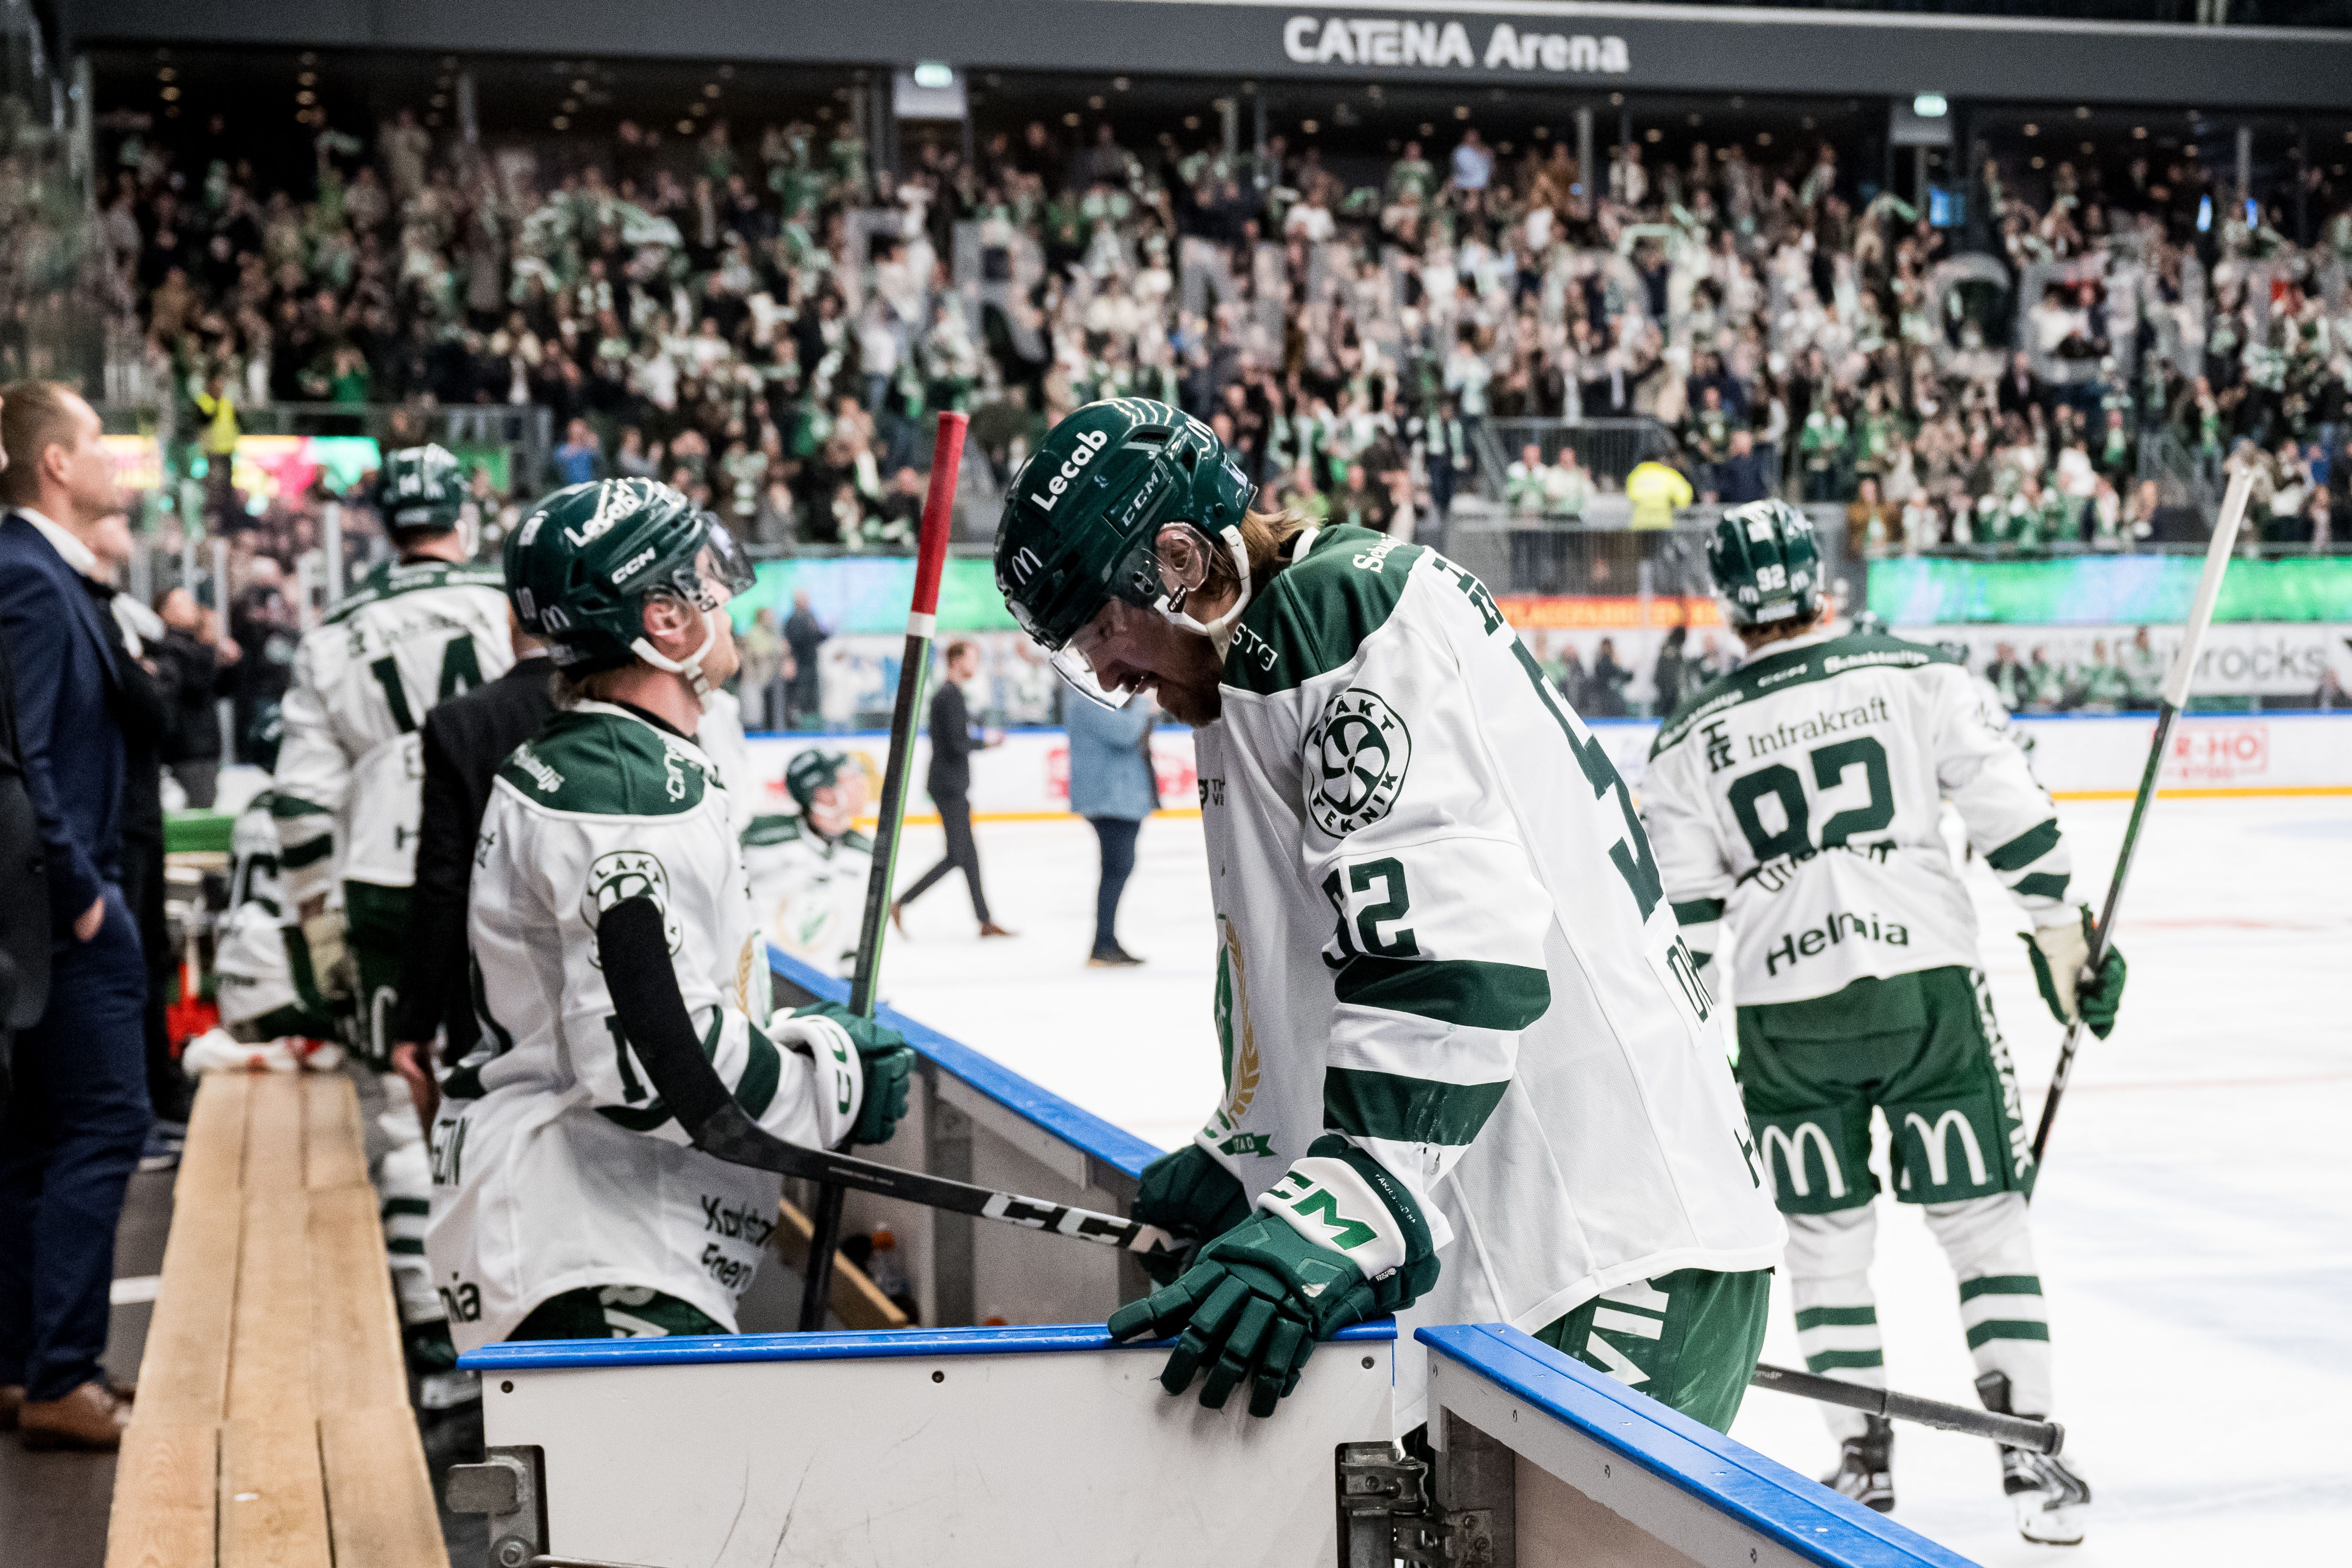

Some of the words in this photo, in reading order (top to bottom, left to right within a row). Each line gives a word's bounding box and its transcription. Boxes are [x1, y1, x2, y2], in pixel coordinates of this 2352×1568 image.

[1284, 15, 1474, 68] CATENA
[1483, 23, 1629, 73] Arena
[1030, 429, 1108, 512] Lecab
[1120, 472, 1159, 527] CCM
[611, 546, 656, 585] CCM
[1756, 563, 1787, 591] 92
[1747, 696, 1890, 759] Infrakraft
[1312, 770, 1399, 832] TEKNIK
